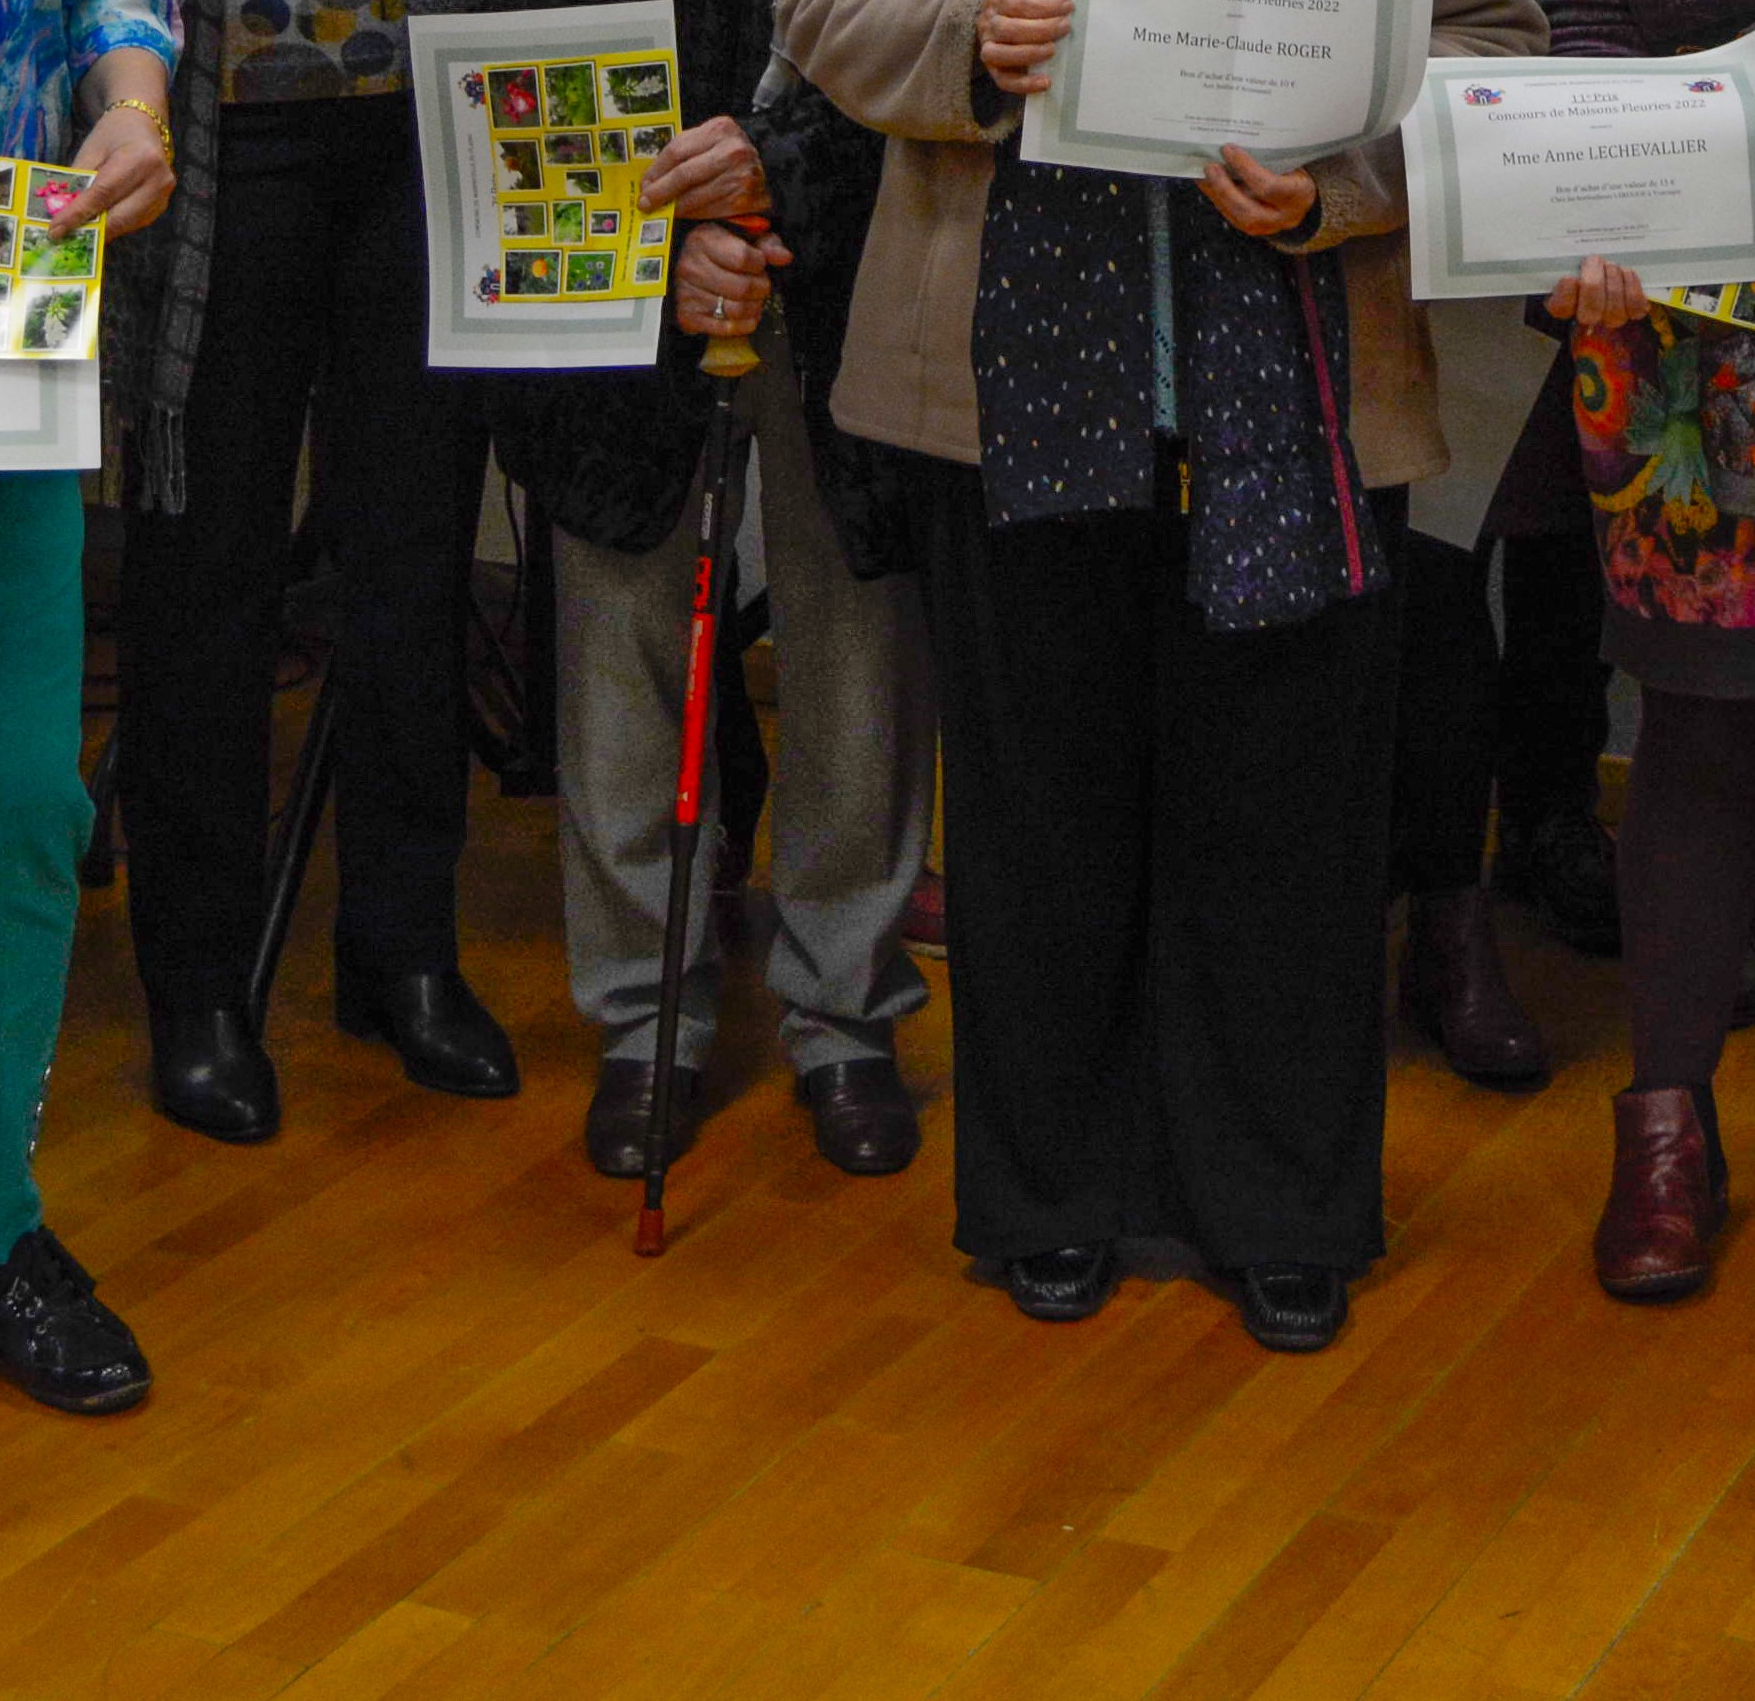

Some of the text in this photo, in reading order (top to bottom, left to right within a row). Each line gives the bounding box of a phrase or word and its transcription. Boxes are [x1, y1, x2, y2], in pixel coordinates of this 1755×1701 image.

[1307, 0, 1339, 12] 2022
[1133, 26, 1331, 60] Mme Marie-Claude ROGER
[1593, 92, 1619, 102] Prix
[1488, 98, 1706, 122] Concours de Maisons Fleuries 2022
[1503, 139, 1707, 166] Mme Anne LECHEVALLIER
